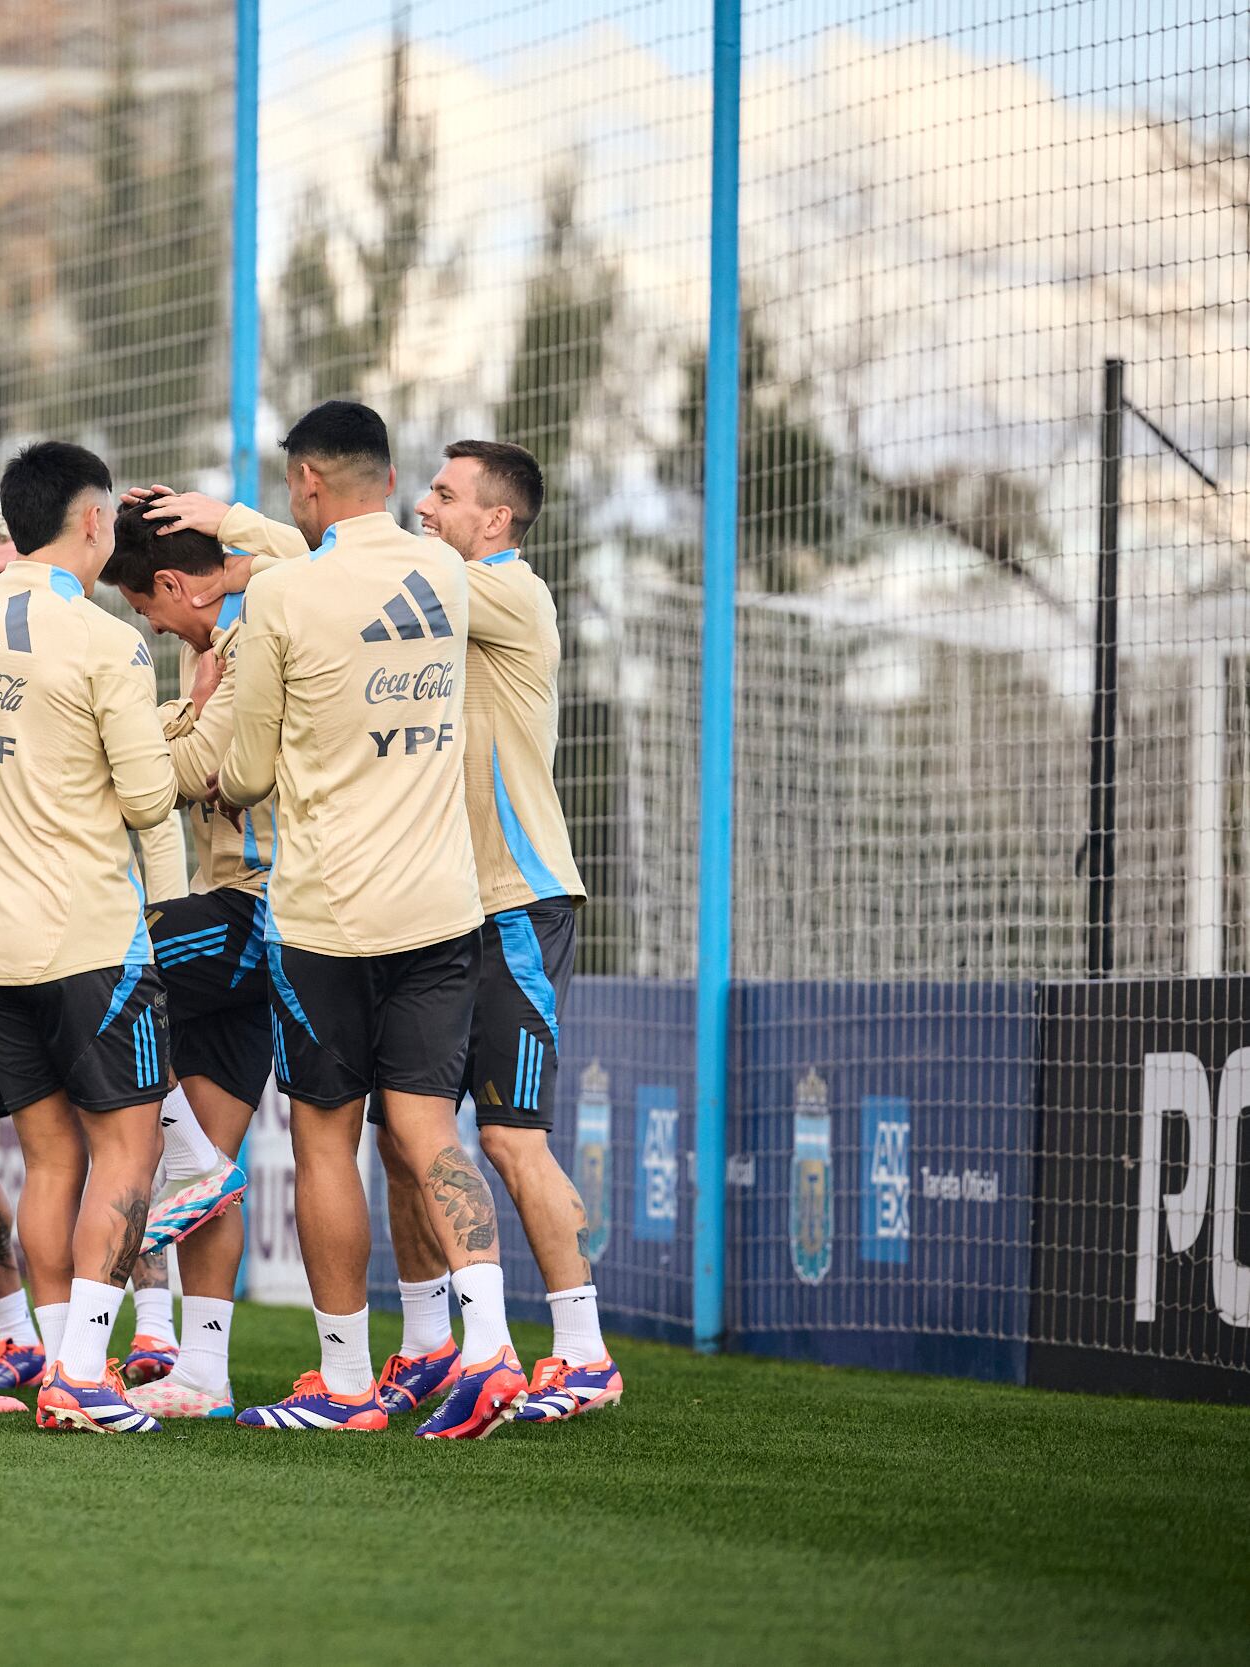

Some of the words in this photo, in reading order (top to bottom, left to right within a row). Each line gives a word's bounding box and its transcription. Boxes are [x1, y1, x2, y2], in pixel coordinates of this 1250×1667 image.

[365, 661, 454, 704] Coca-Cola
[368, 723, 453, 757] YPF
[961, 1168, 999, 1203] Oficial
